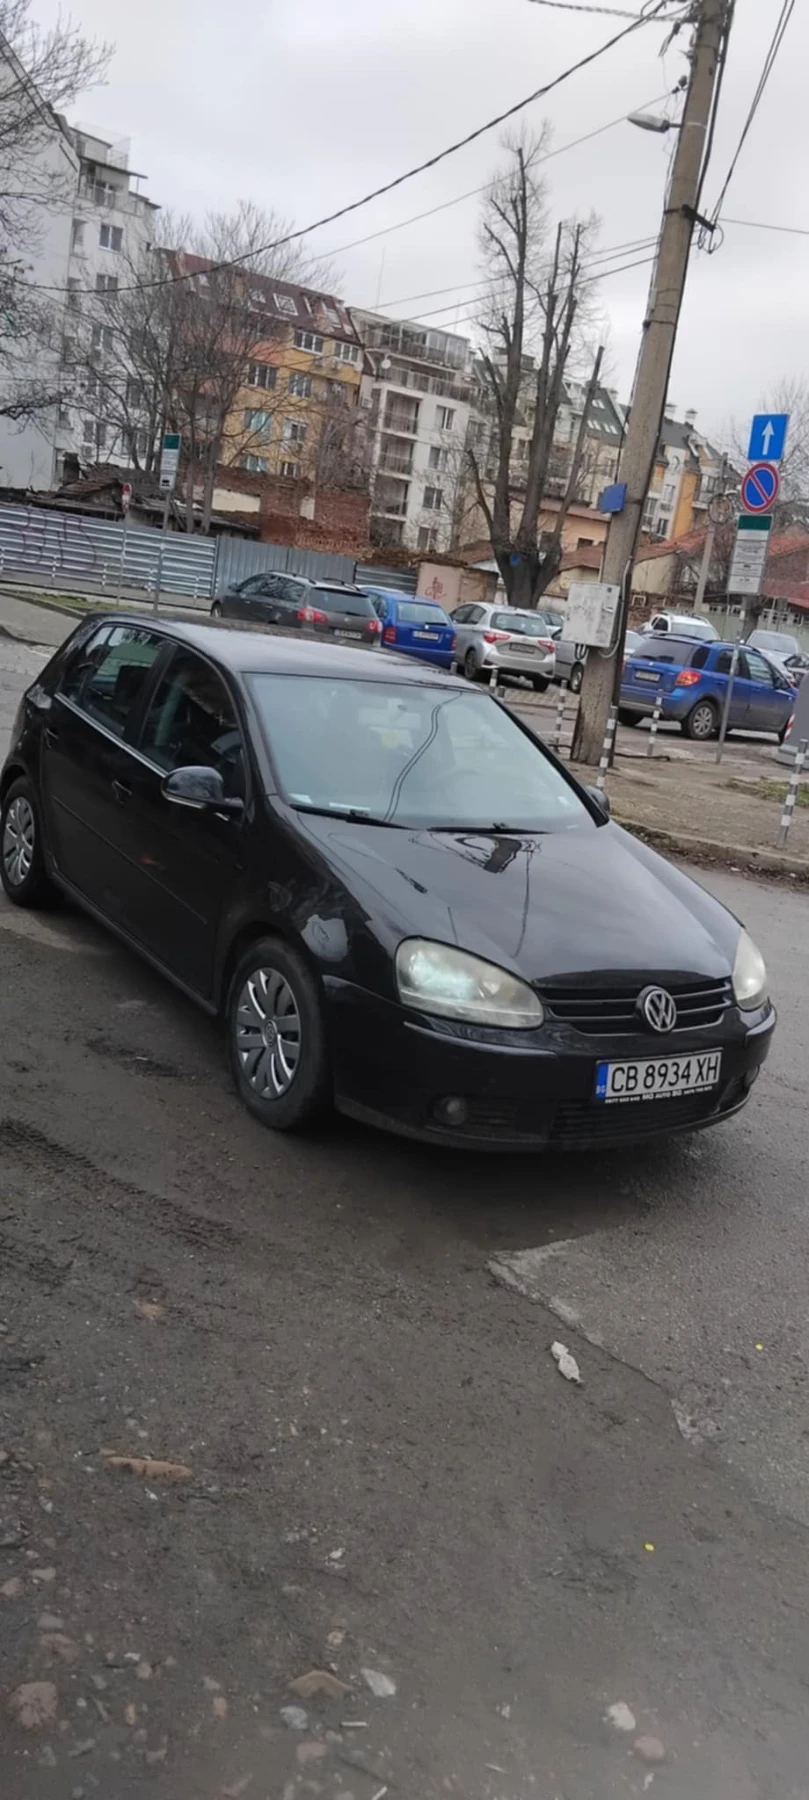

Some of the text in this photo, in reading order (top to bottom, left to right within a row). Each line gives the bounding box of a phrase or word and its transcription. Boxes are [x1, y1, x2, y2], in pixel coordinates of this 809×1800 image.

[611, 1056, 719, 1093] CB 8934 XH
